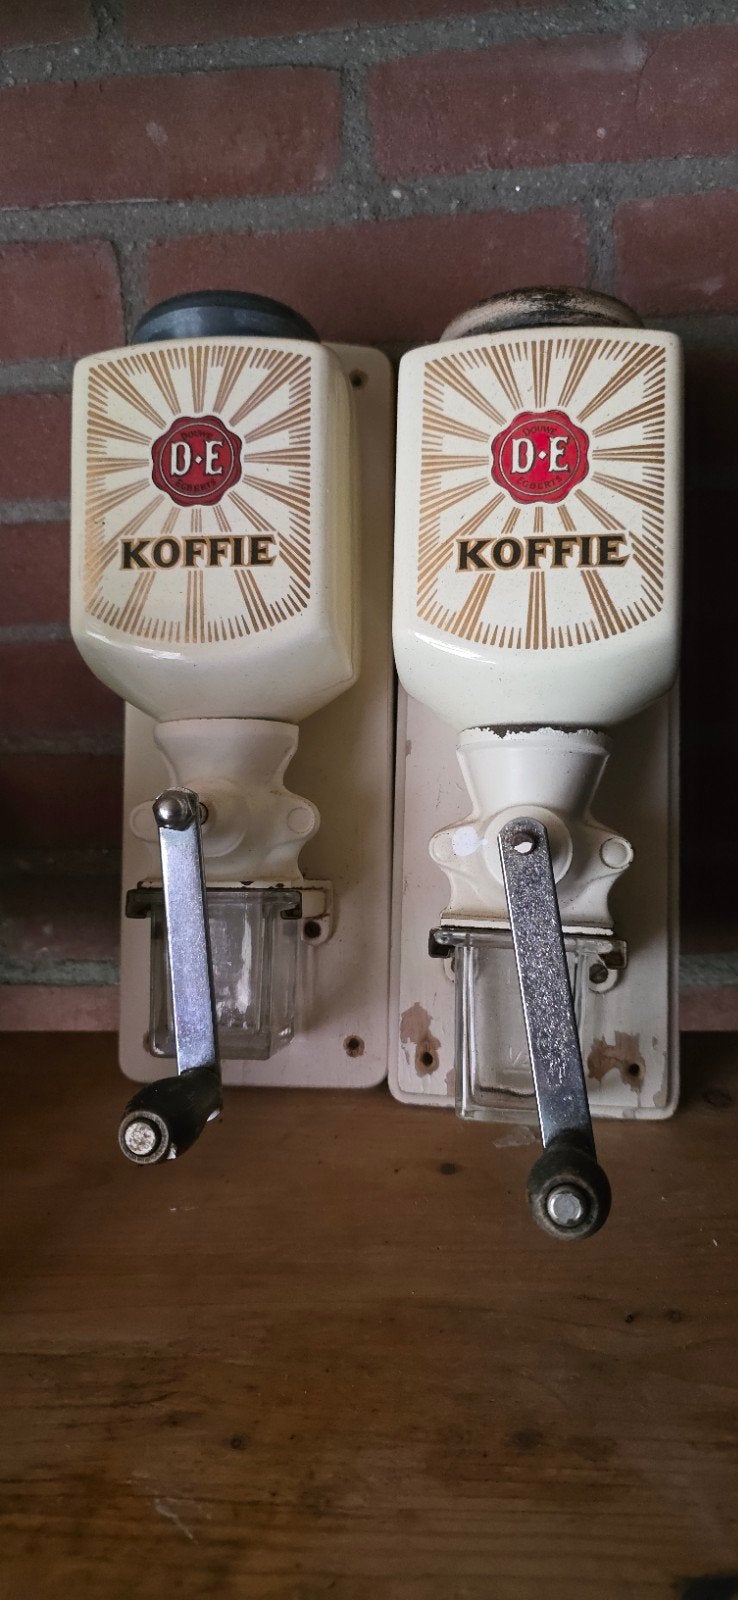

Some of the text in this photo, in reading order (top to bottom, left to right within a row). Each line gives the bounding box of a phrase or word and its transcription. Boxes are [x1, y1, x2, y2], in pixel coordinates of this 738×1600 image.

[522, 425, 557, 437] DOUWE
[517, 475, 563, 489] EGBERTS
[120, 534, 278, 570] KOFFIE
[455, 533, 630, 572] KOFFIE
